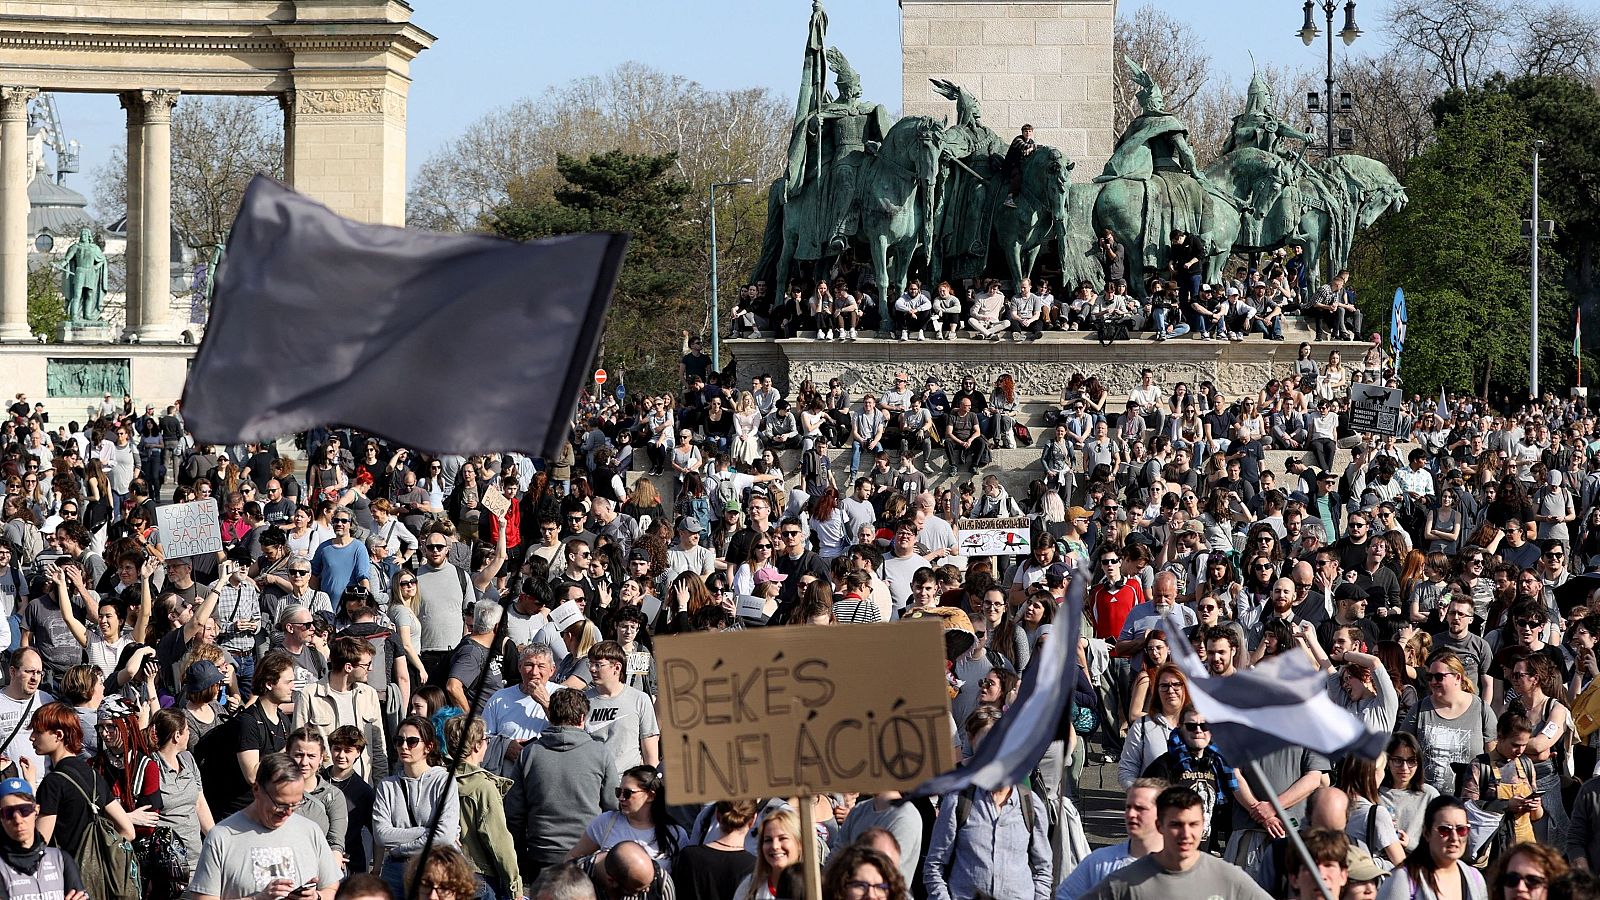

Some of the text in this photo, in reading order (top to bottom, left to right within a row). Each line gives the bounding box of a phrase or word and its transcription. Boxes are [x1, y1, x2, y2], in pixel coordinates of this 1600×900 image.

[164, 502, 213, 519] SOHA NE
[168, 513, 214, 530] LEGYEN
[663, 651, 835, 730] BÉKÉS
[590, 707, 619, 722] NIKE
